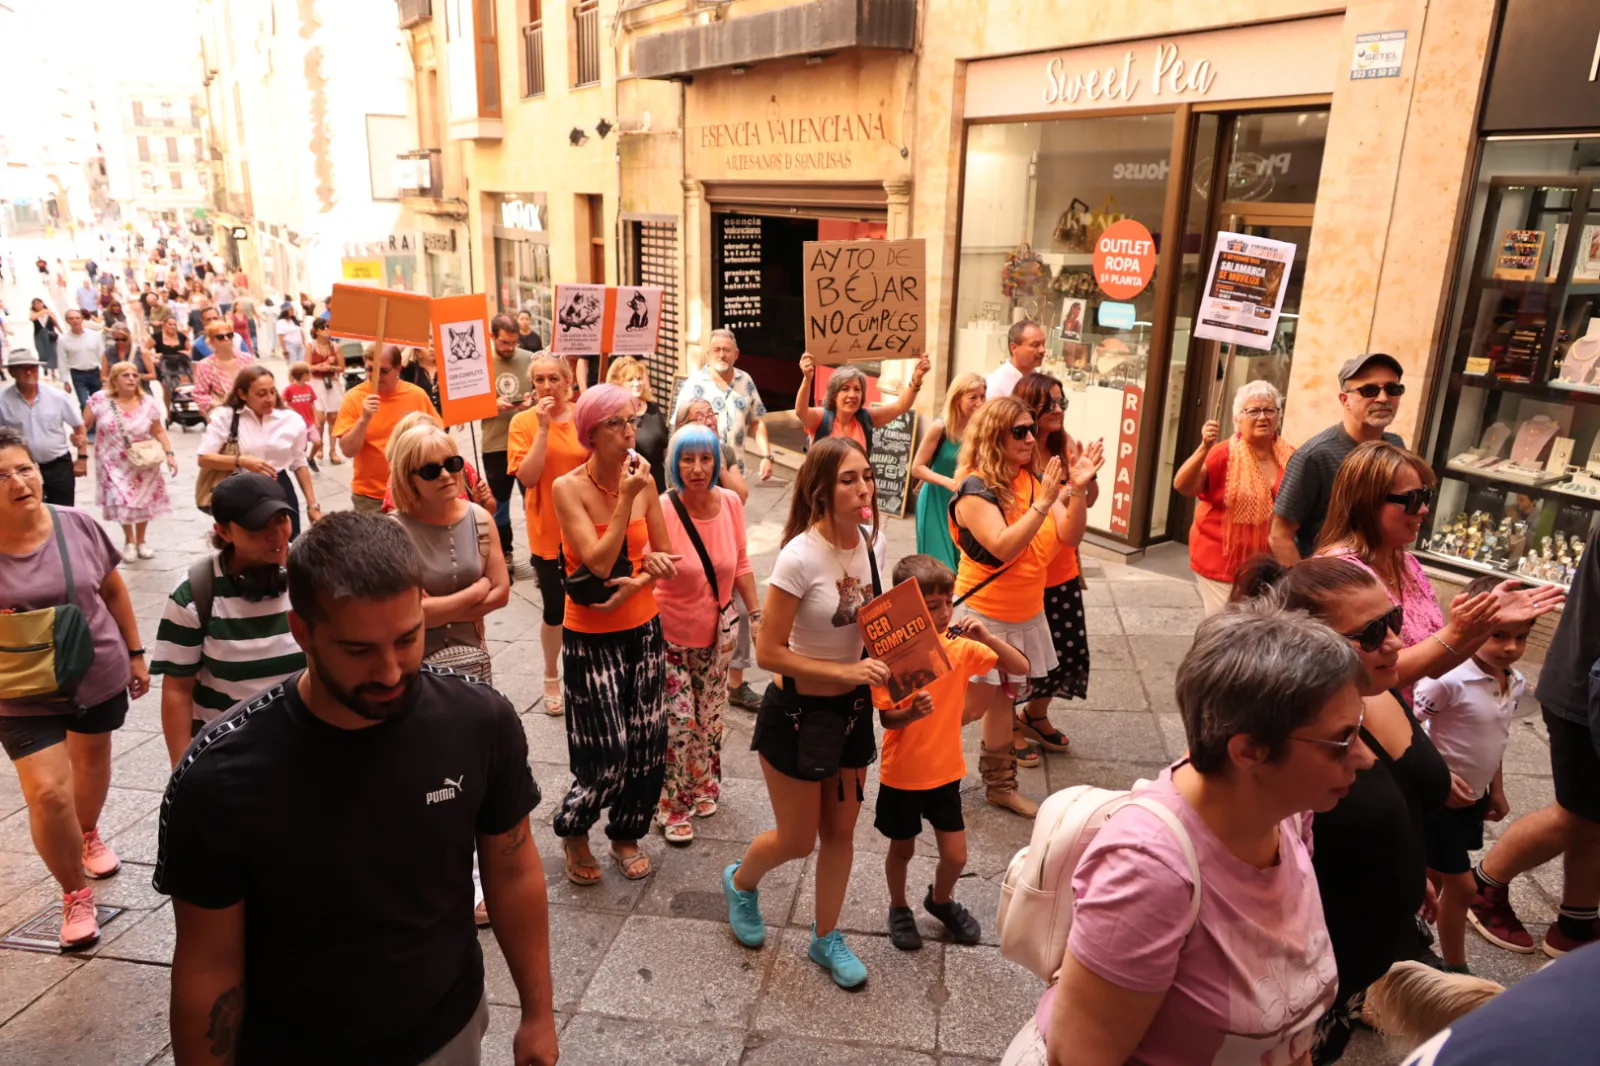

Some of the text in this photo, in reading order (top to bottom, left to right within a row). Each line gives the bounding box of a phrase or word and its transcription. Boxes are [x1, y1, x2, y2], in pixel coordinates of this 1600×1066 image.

[1044, 42, 1217, 105] Sweet Pea
[701, 113, 887, 148] ESENCIA VALENCIANA
[724, 153, 782, 171] ARTESANOS
[795, 151, 852, 170] SONRISAS
[724, 217, 761, 226] esencia
[724, 226, 761, 235] valenciana
[1100, 238, 1152, 256] OUTLET
[810, 247, 912, 272] AYTO DE
[1105, 256, 1140, 273] ROPA
[1218, 270, 1227, 280] SE
[1220, 261, 1266, 278] SALAMANCA
[724, 282, 761, 290] naturales
[1111, 274, 1143, 287] PLANTA
[811, 309, 919, 340] NO CUMPLES
[828, 338, 862, 354] LA
[866, 333, 912, 353] LEY
[1117, 393, 1138, 485] ROPA
[866, 616, 893, 641] CER
[874, 617, 927, 656] COMPLETO
[426, 788, 455, 805] PUMA
